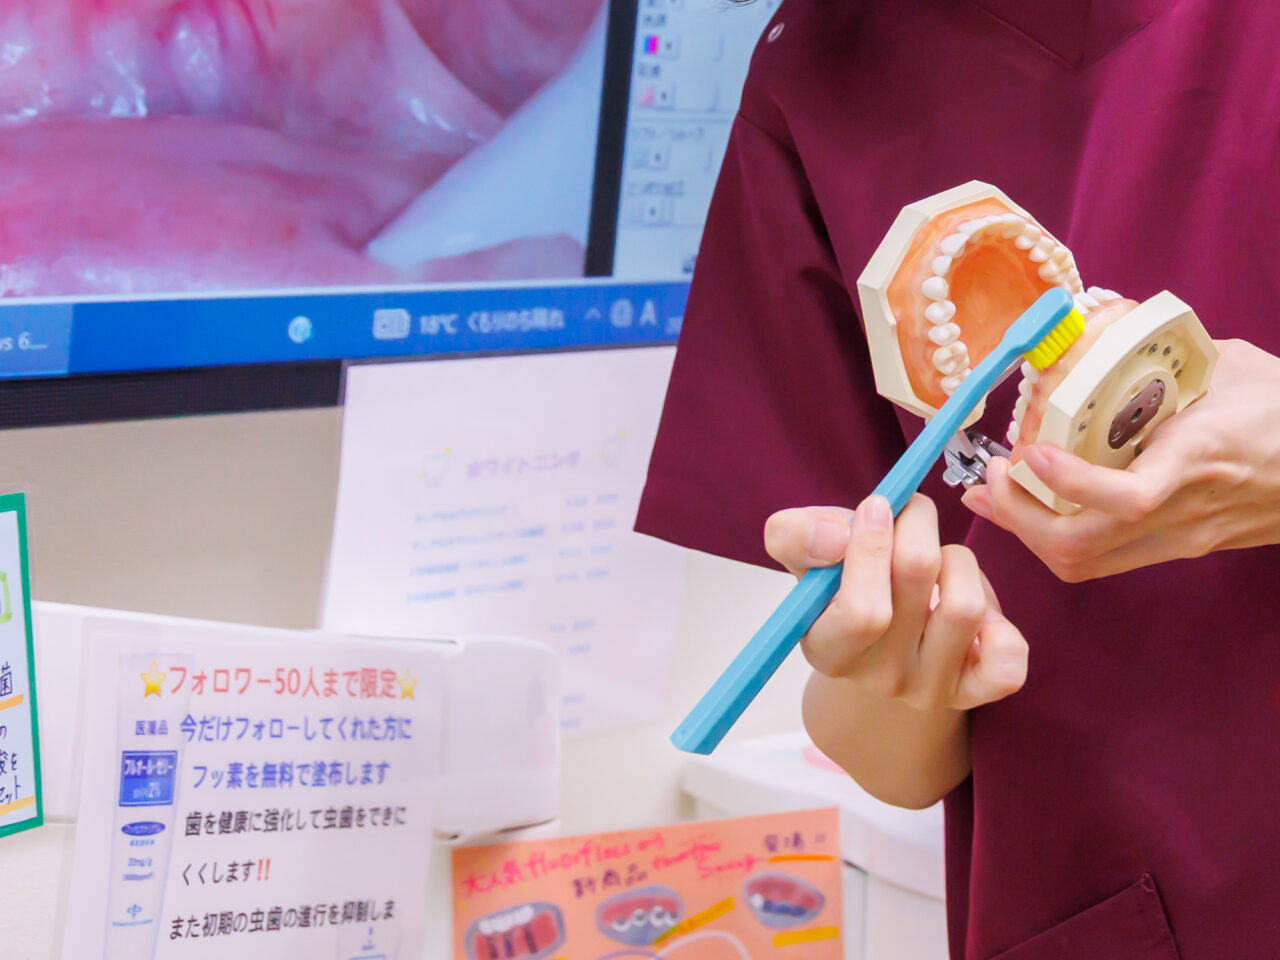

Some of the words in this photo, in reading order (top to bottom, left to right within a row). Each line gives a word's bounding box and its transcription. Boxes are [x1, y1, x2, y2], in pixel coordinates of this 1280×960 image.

[169, 666, 397, 699] フォロワー50人まで限定
[180, 713, 412, 742] 今だけフォローしてくれた方に
[192, 760, 391, 790] フッ素を無料で塗布します
[184, 805, 408, 837] 歯を健康に強化して虫歯をできに
[169, 898, 396, 940] また初期の虫歯の進行を抑制しま
